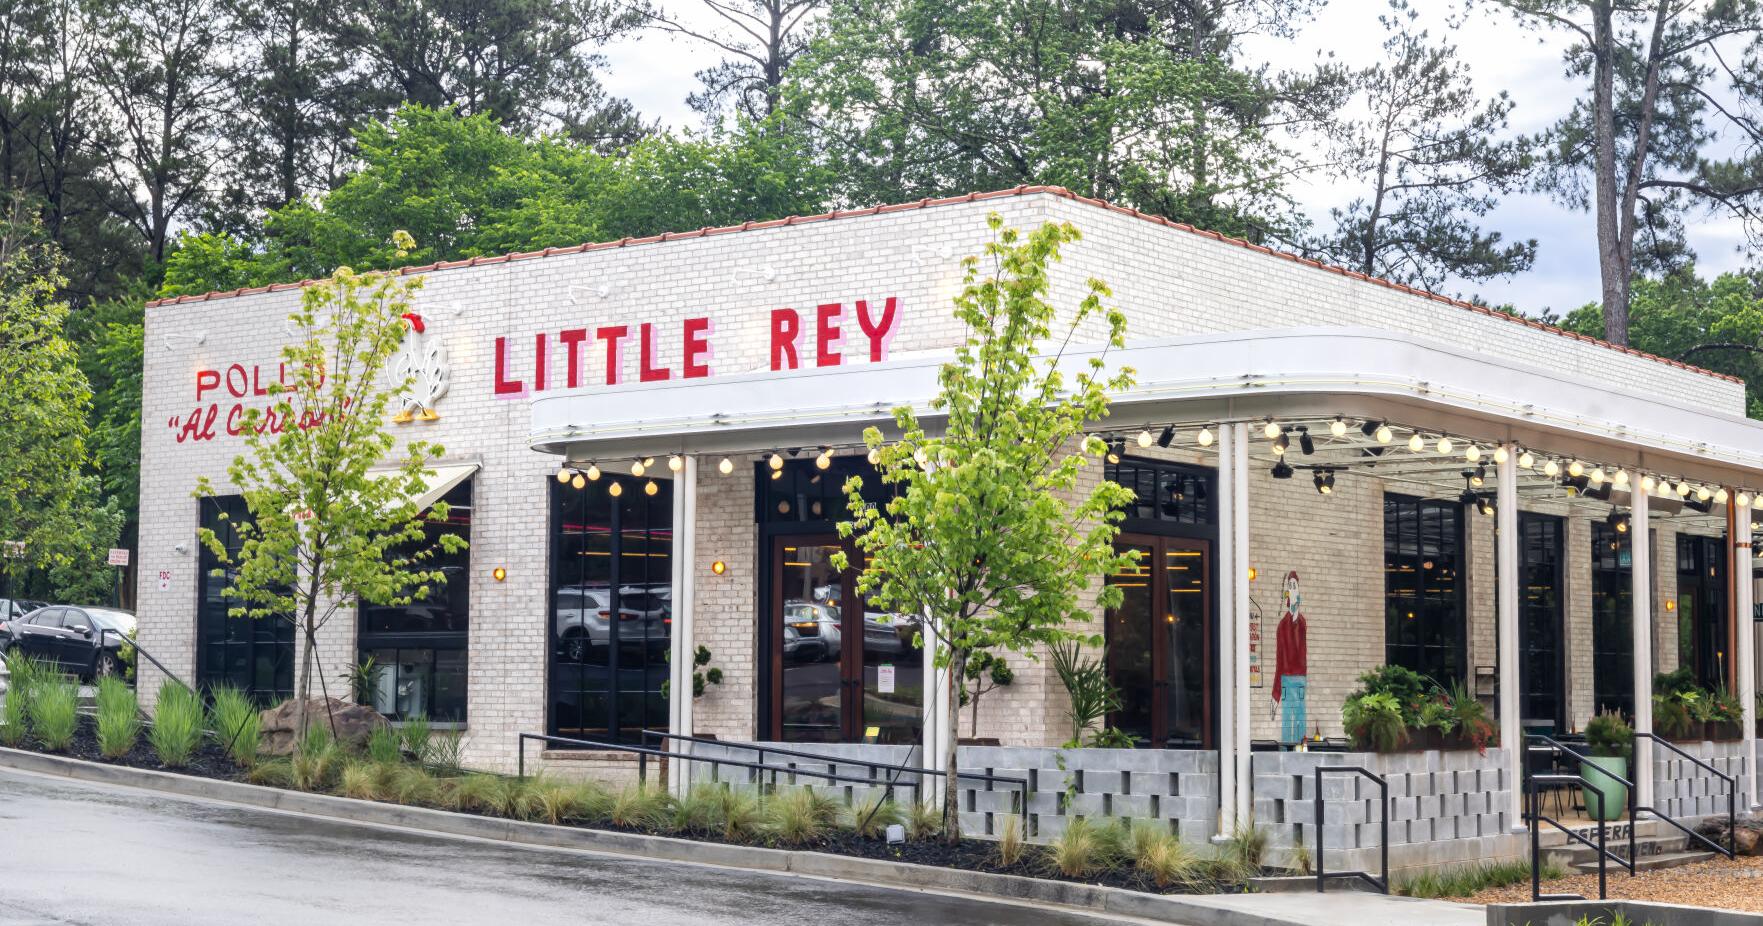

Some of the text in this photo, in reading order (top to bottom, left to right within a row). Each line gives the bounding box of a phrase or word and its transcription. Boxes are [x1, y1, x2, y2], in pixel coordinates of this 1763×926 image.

[494, 296, 902, 399] LITTLE REY
[159, 571, 170, 580] FDC
